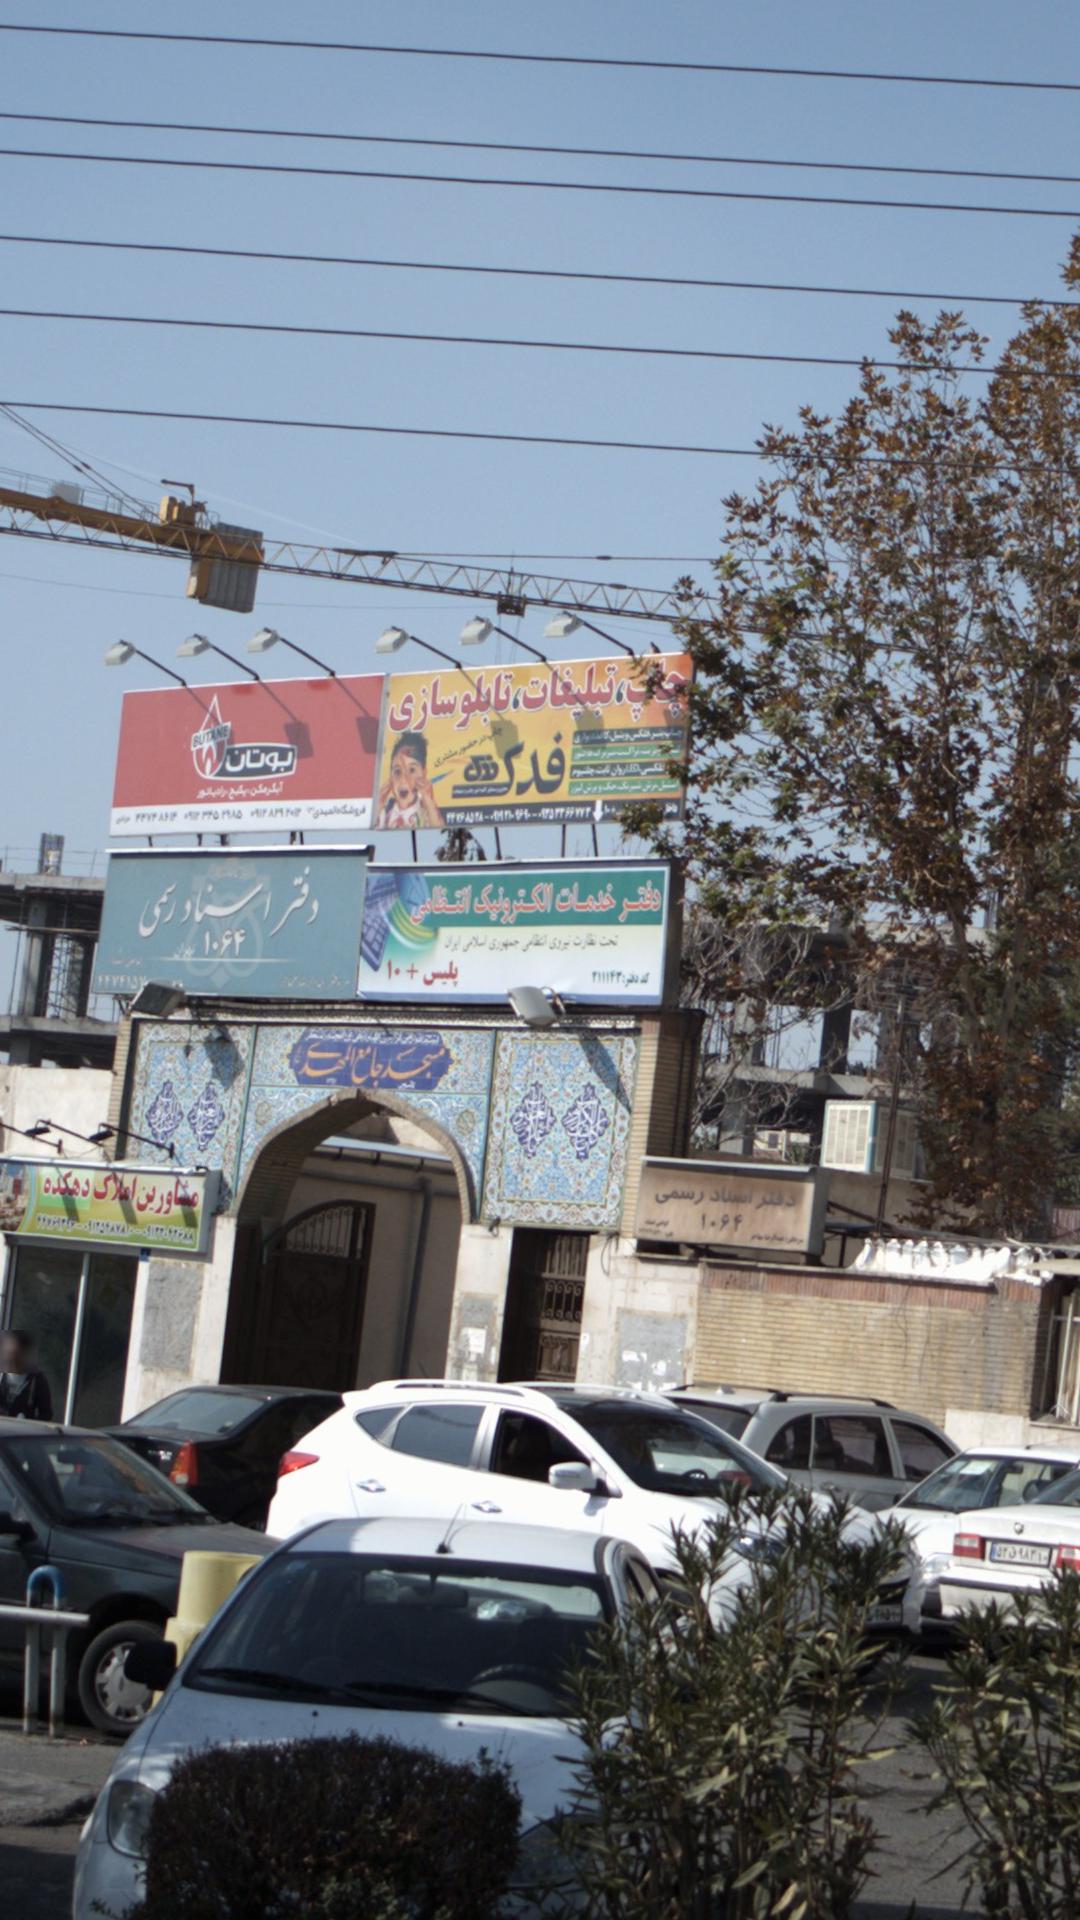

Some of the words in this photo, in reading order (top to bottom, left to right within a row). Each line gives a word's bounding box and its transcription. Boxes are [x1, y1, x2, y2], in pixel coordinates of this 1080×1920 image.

[192, 723, 230, 748] BUTANE
[226, 747, 294, 772] بوتان
[139, 883, 177, 937] رسمی
[181, 883, 271, 923] اسناد
[270, 866, 319, 937] دفتر
[410, 884, 472, 926] انتظامی
[473, 882, 554, 925] الکترونیک
[555, 881, 617, 912] خدمات
[618, 880, 661, 922] دفتر
[204, 929, 246, 956] ۱۰۶۴
[444, 936, 461, 952] ایران
[462, 935, 488, 952] اسلامی
[488, 937, 519, 952] جمهوری
[522, 934, 547, 952] انتظامی
[549, 936, 571, 951] نیروی
[600, 934, 619, 947] تحت
[423, 960, 459, 987] پلیس
[381, 1045, 446, 1080] مسجد
[43, 1171, 90, 1198] دهکده
[93, 1172, 137, 1201] املاک
[136, 1178, 200, 1214] مشاورین
[655, 1189, 704, 1205] رسمی
[709, 1187, 752, 1204] اسناد
[755, 1187, 796, 1209] دفتر
[701, 1213, 743, 1232] ۱۰۶۴
